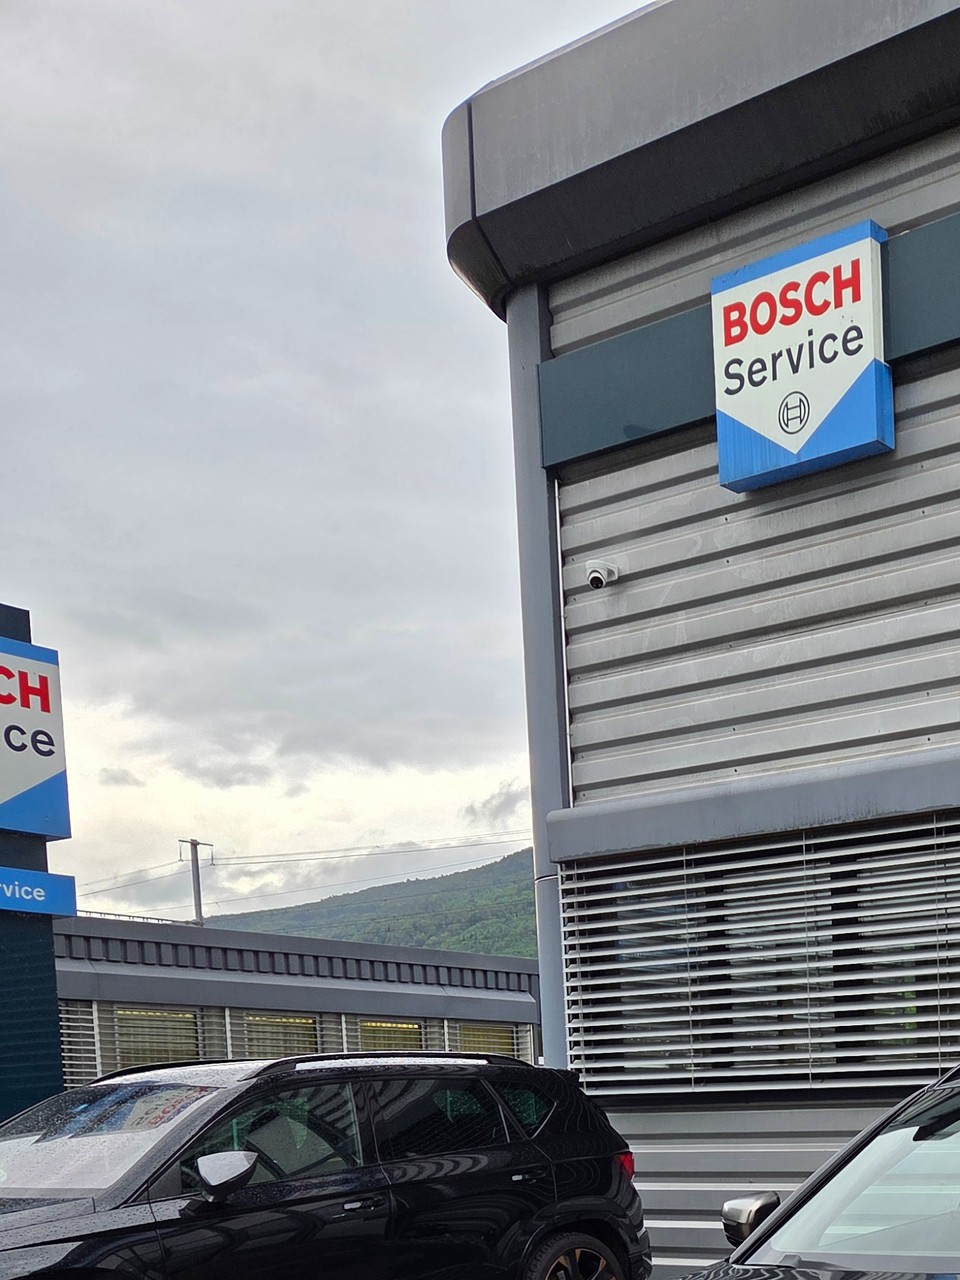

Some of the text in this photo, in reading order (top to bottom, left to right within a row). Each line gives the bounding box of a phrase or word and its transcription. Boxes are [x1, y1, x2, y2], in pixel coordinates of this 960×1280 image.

[723, 258, 862, 347] BOSCH
[723, 325, 864, 395] Service
[0, 881, 46, 901] vice
